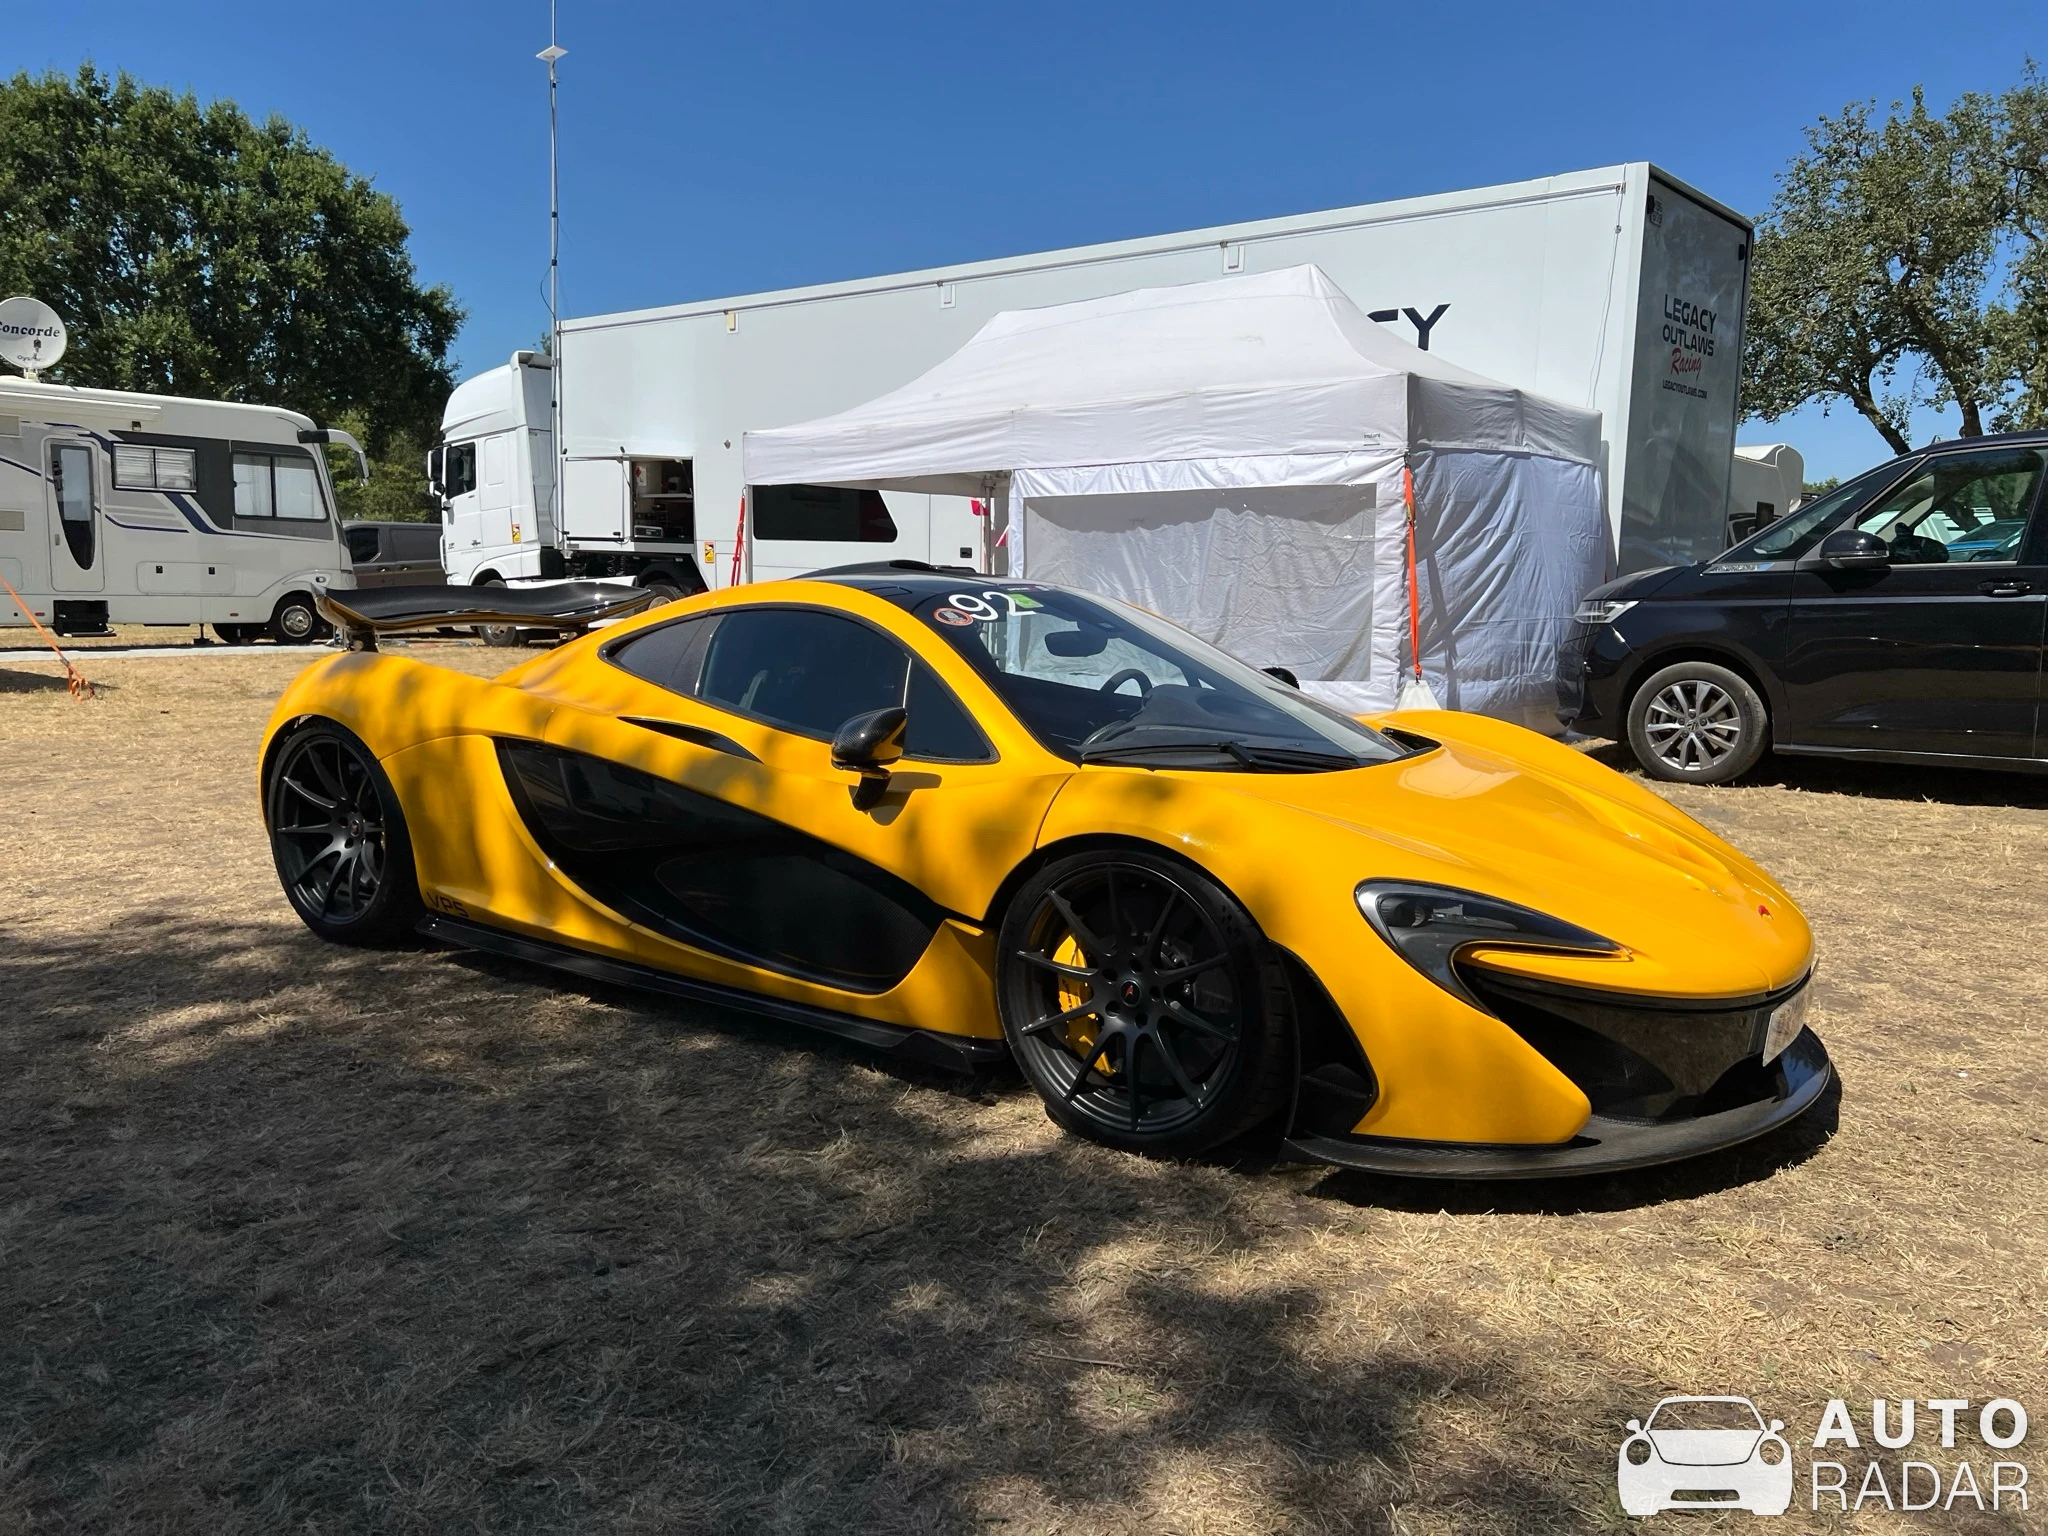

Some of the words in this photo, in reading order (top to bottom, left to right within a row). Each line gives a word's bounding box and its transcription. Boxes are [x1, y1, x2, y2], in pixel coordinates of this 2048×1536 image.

[1664, 294, 1717, 335] LEGACY
[1662, 324, 1715, 357] OUTLAWS
[1670, 347, 1702, 381] Racing
[1662, 379, 1708, 399] LEGACYOUTLAWS.COM
[948, 591, 1037, 621] 92
